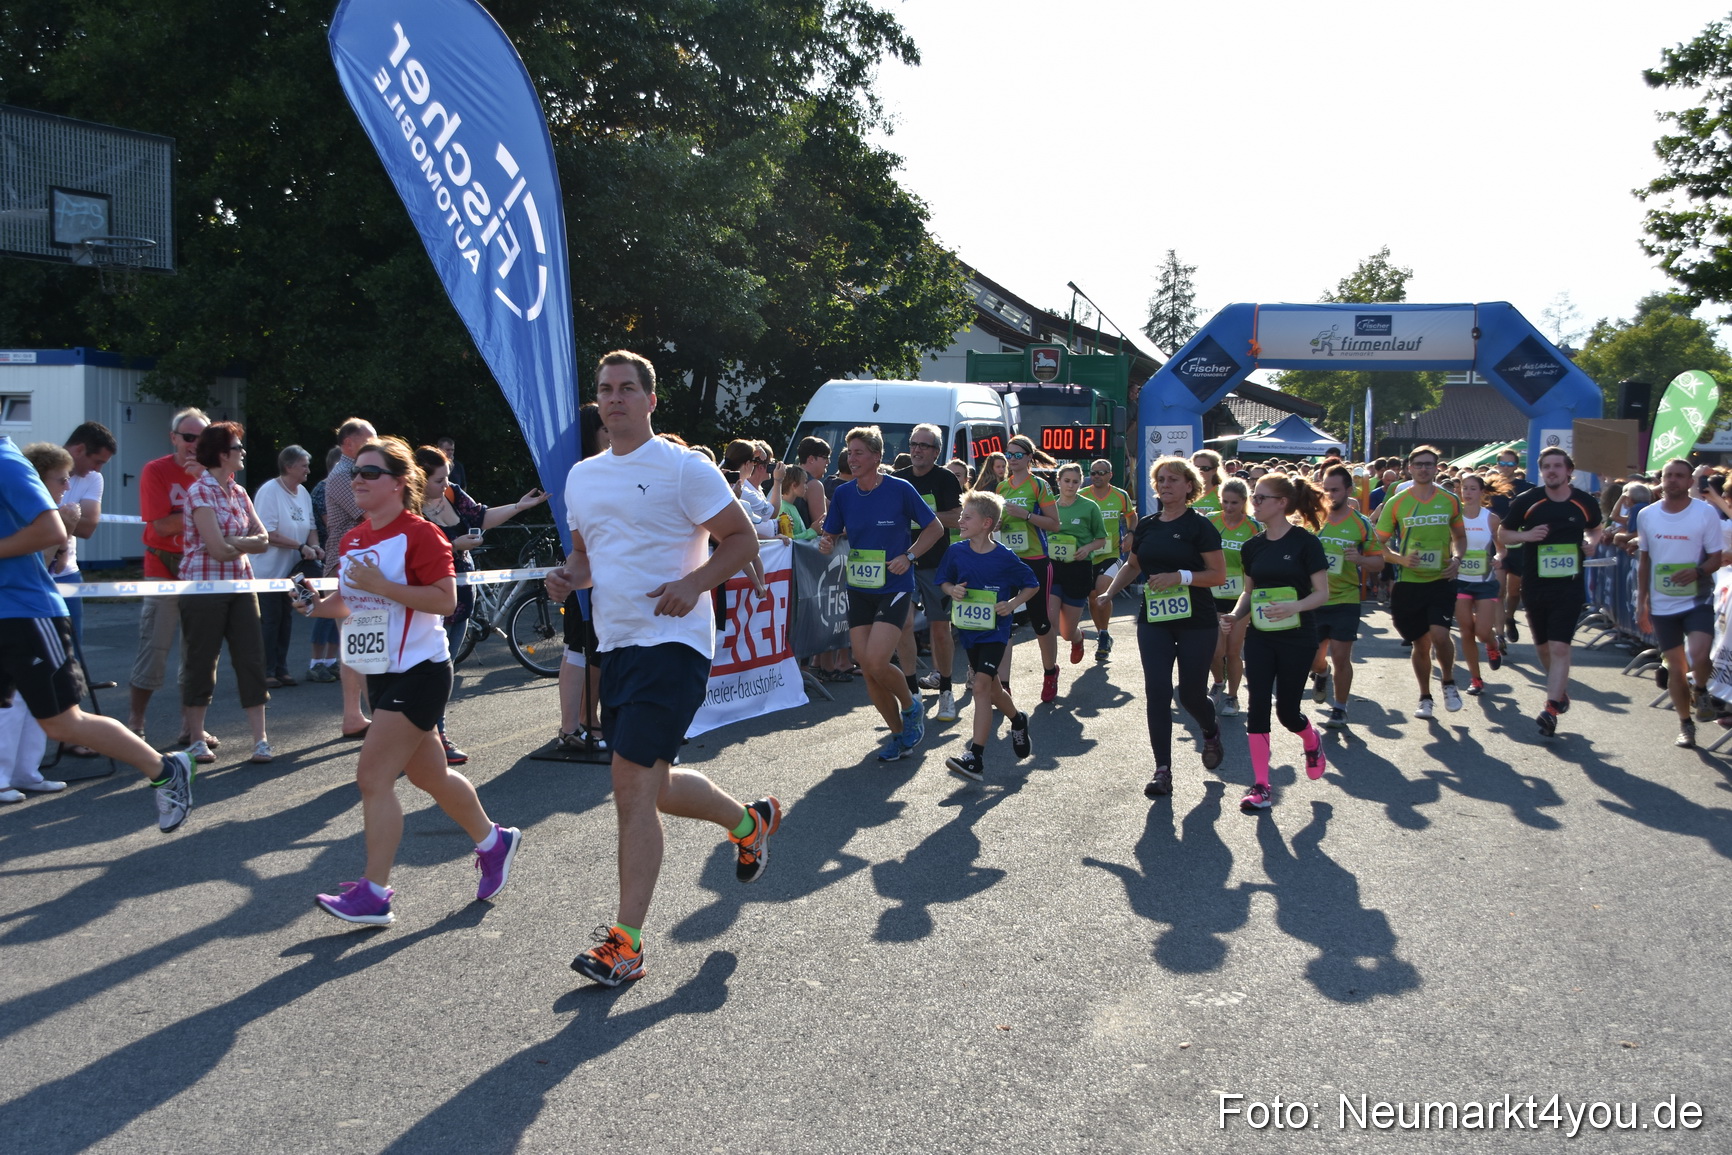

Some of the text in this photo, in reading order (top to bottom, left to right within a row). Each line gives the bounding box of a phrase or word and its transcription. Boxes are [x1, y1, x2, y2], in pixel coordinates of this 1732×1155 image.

[1361, 321, 1390, 331] Fischer
[1341, 336, 1423, 351] firmenlauf
[1189, 363, 1231, 373] Fischer
[1652, 426, 1682, 458] AOK
[1403, 514, 1449, 528] BOCK
[1006, 534, 1024, 545] 155
[1054, 545, 1067, 556] 23
[1542, 557, 1574, 569] 1549
[850, 563, 881, 578] 1497
[956, 604, 992, 620] 1498
[1149, 596, 1189, 616] 5189
[347, 631, 385, 655] 8925
